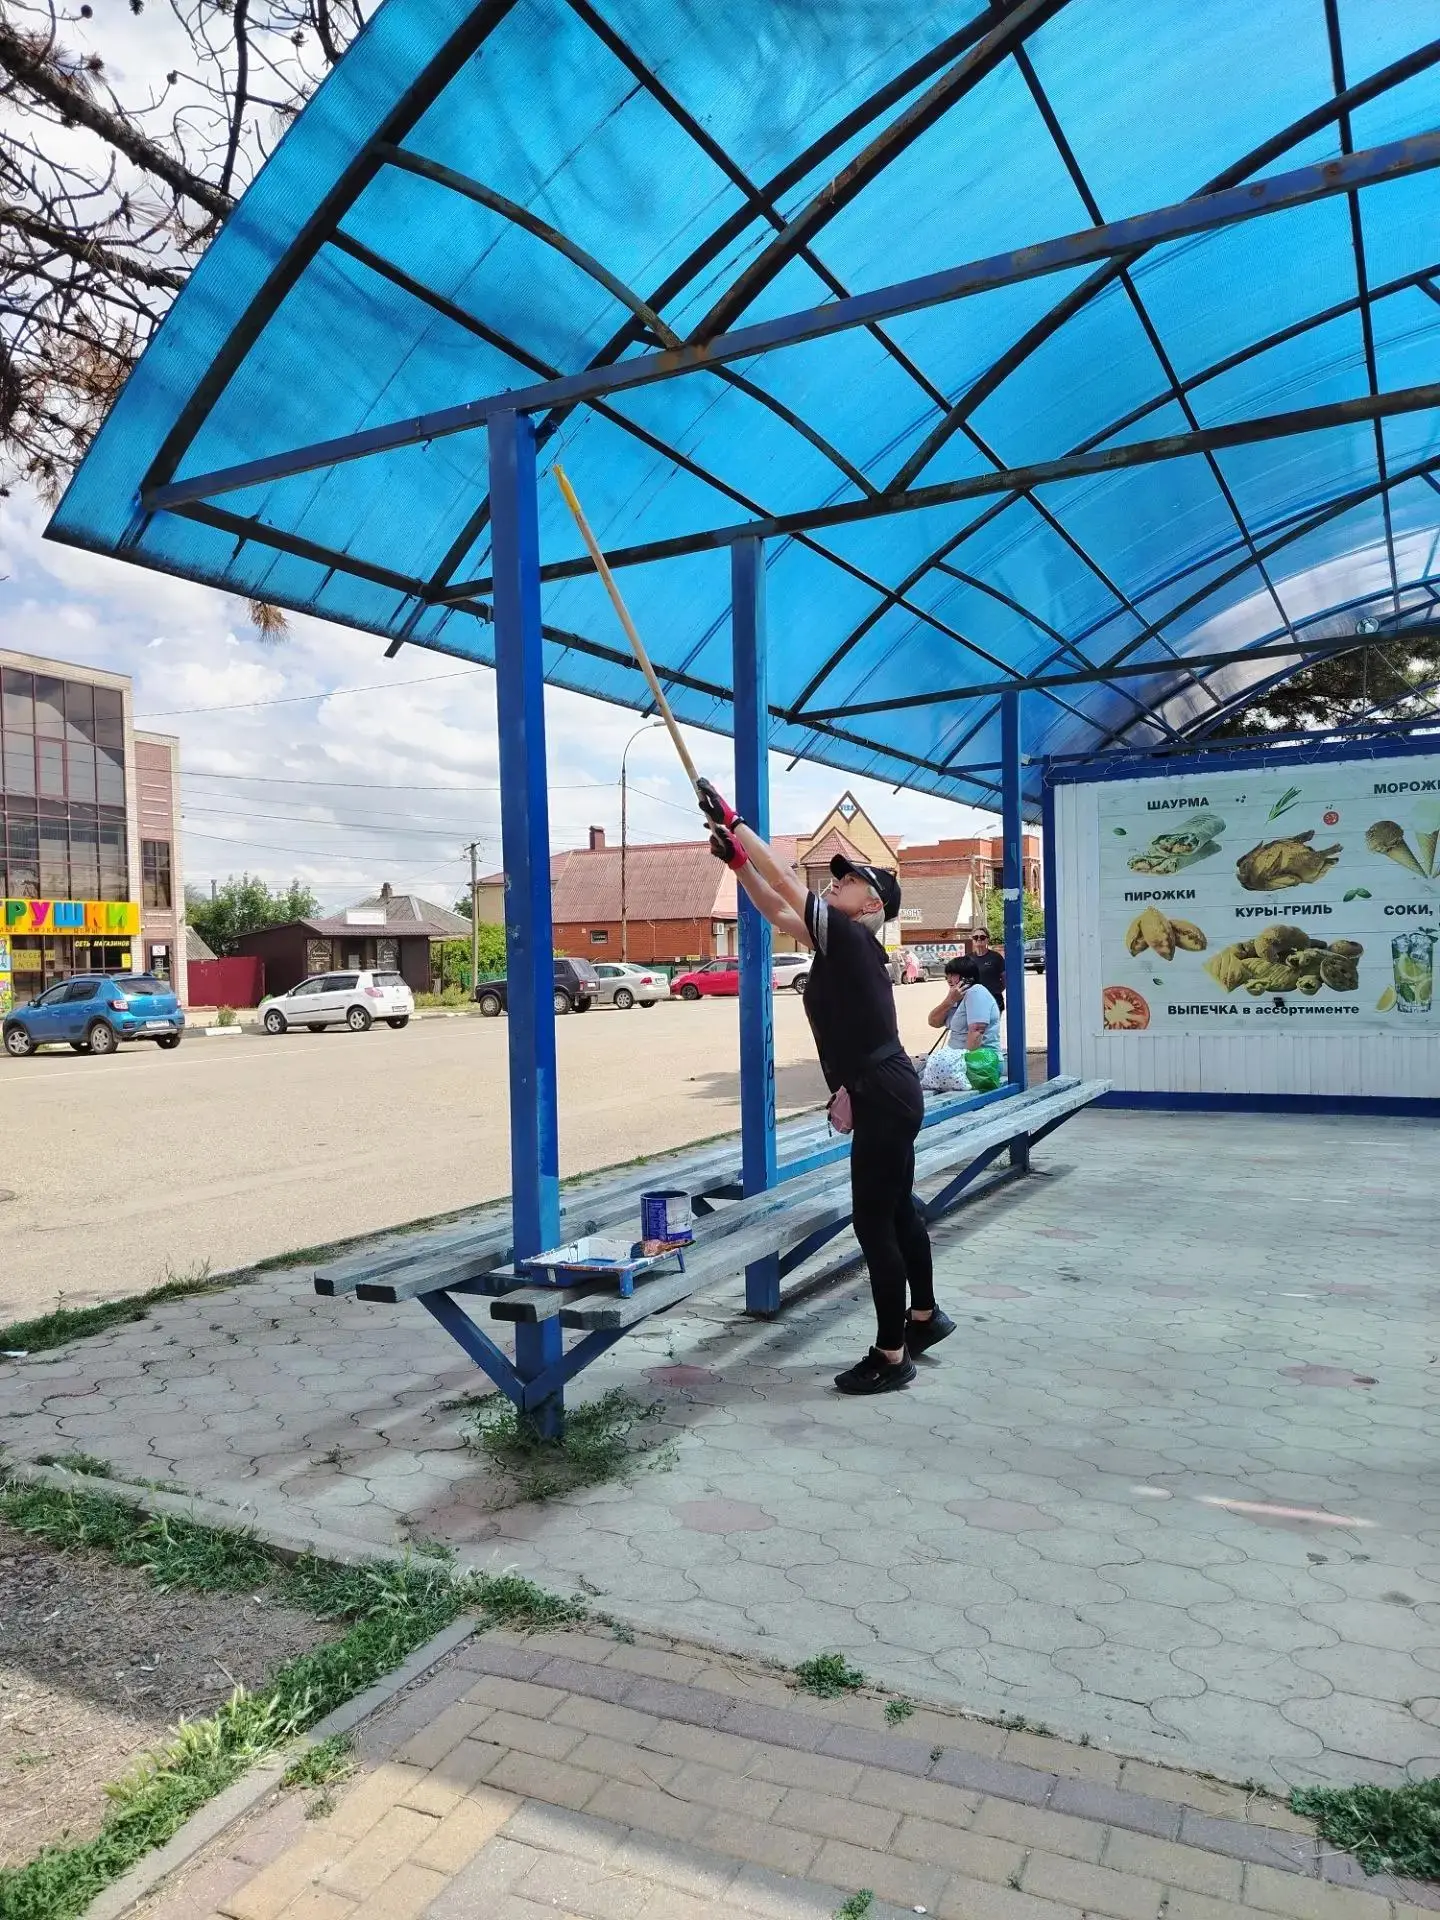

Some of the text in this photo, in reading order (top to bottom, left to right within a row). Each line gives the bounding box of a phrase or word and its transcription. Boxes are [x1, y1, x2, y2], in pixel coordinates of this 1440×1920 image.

[1374, 780, 1440, 794] МОРОЖ
[1147, 797, 1210, 810] ШАУРМА
[1124, 890, 1196, 902] ПИРОЖКИ
[1235, 904, 1333, 918] КУРЫ-ГРИЛЬ
[1384, 904, 1434, 916] СОКИ,
[74, 940, 130, 948] СЕТЬ МАГАЗИНОВ
[914, 944, 957, 952] ОКНА
[1168, 1005, 1360, 1016] ВЫПЕЧКА в ассортименте
